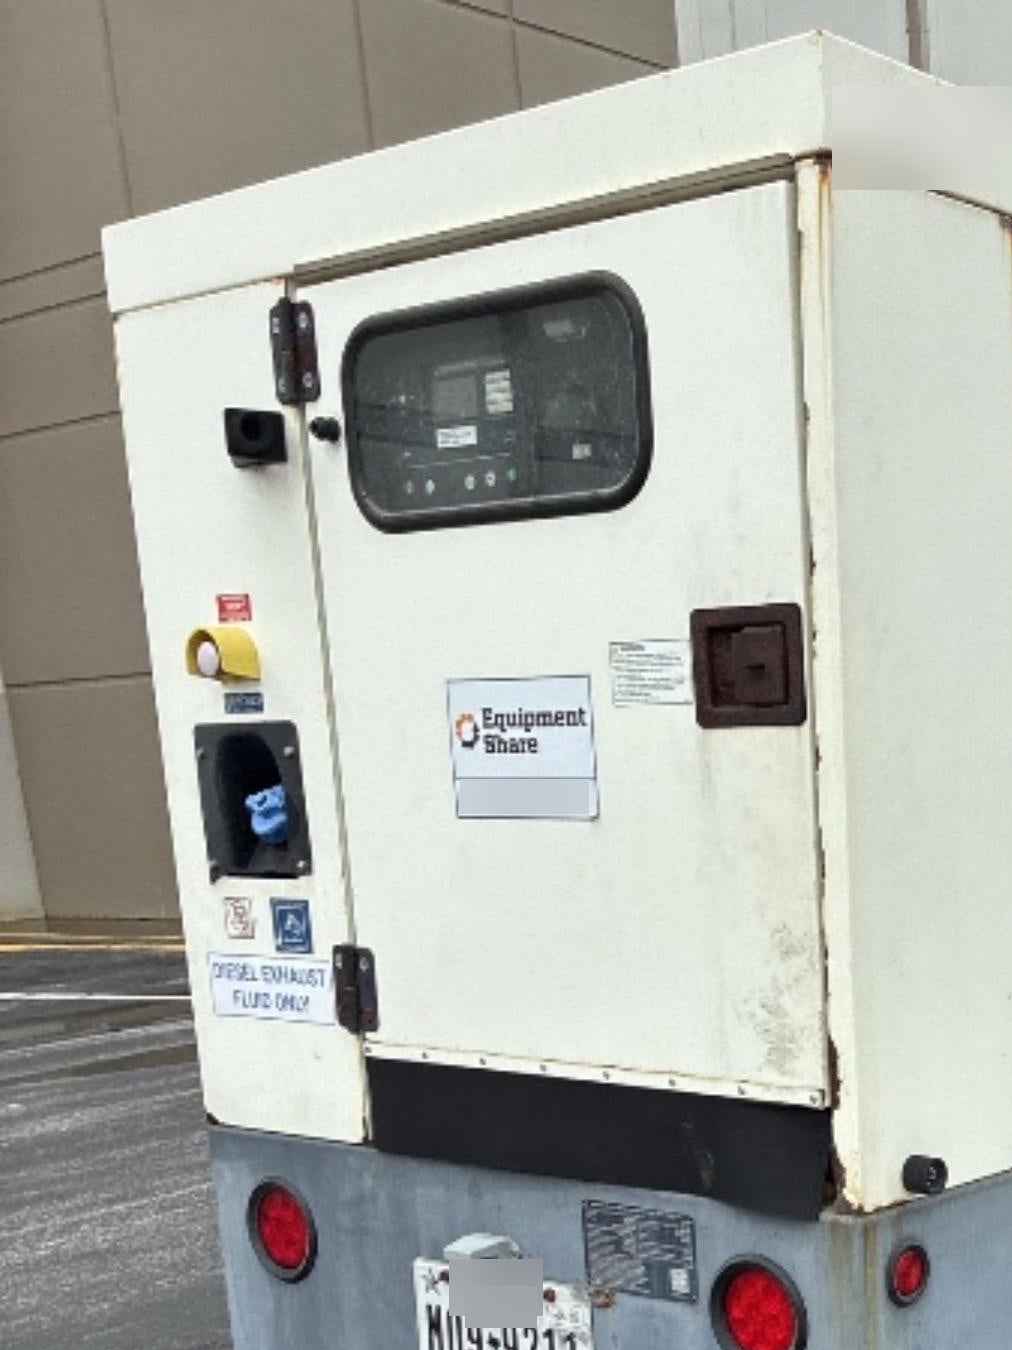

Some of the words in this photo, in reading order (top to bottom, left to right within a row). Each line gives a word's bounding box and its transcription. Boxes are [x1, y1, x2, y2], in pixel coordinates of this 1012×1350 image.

[481, 706, 587, 732] Equipment
[483, 733, 540, 755] Share
[211, 962, 259, 982] DIESEL
[260, 965, 326, 988] EXHAUST
[232, 989, 272, 1009] FLUID
[274, 992, 310, 1013] ONLY
